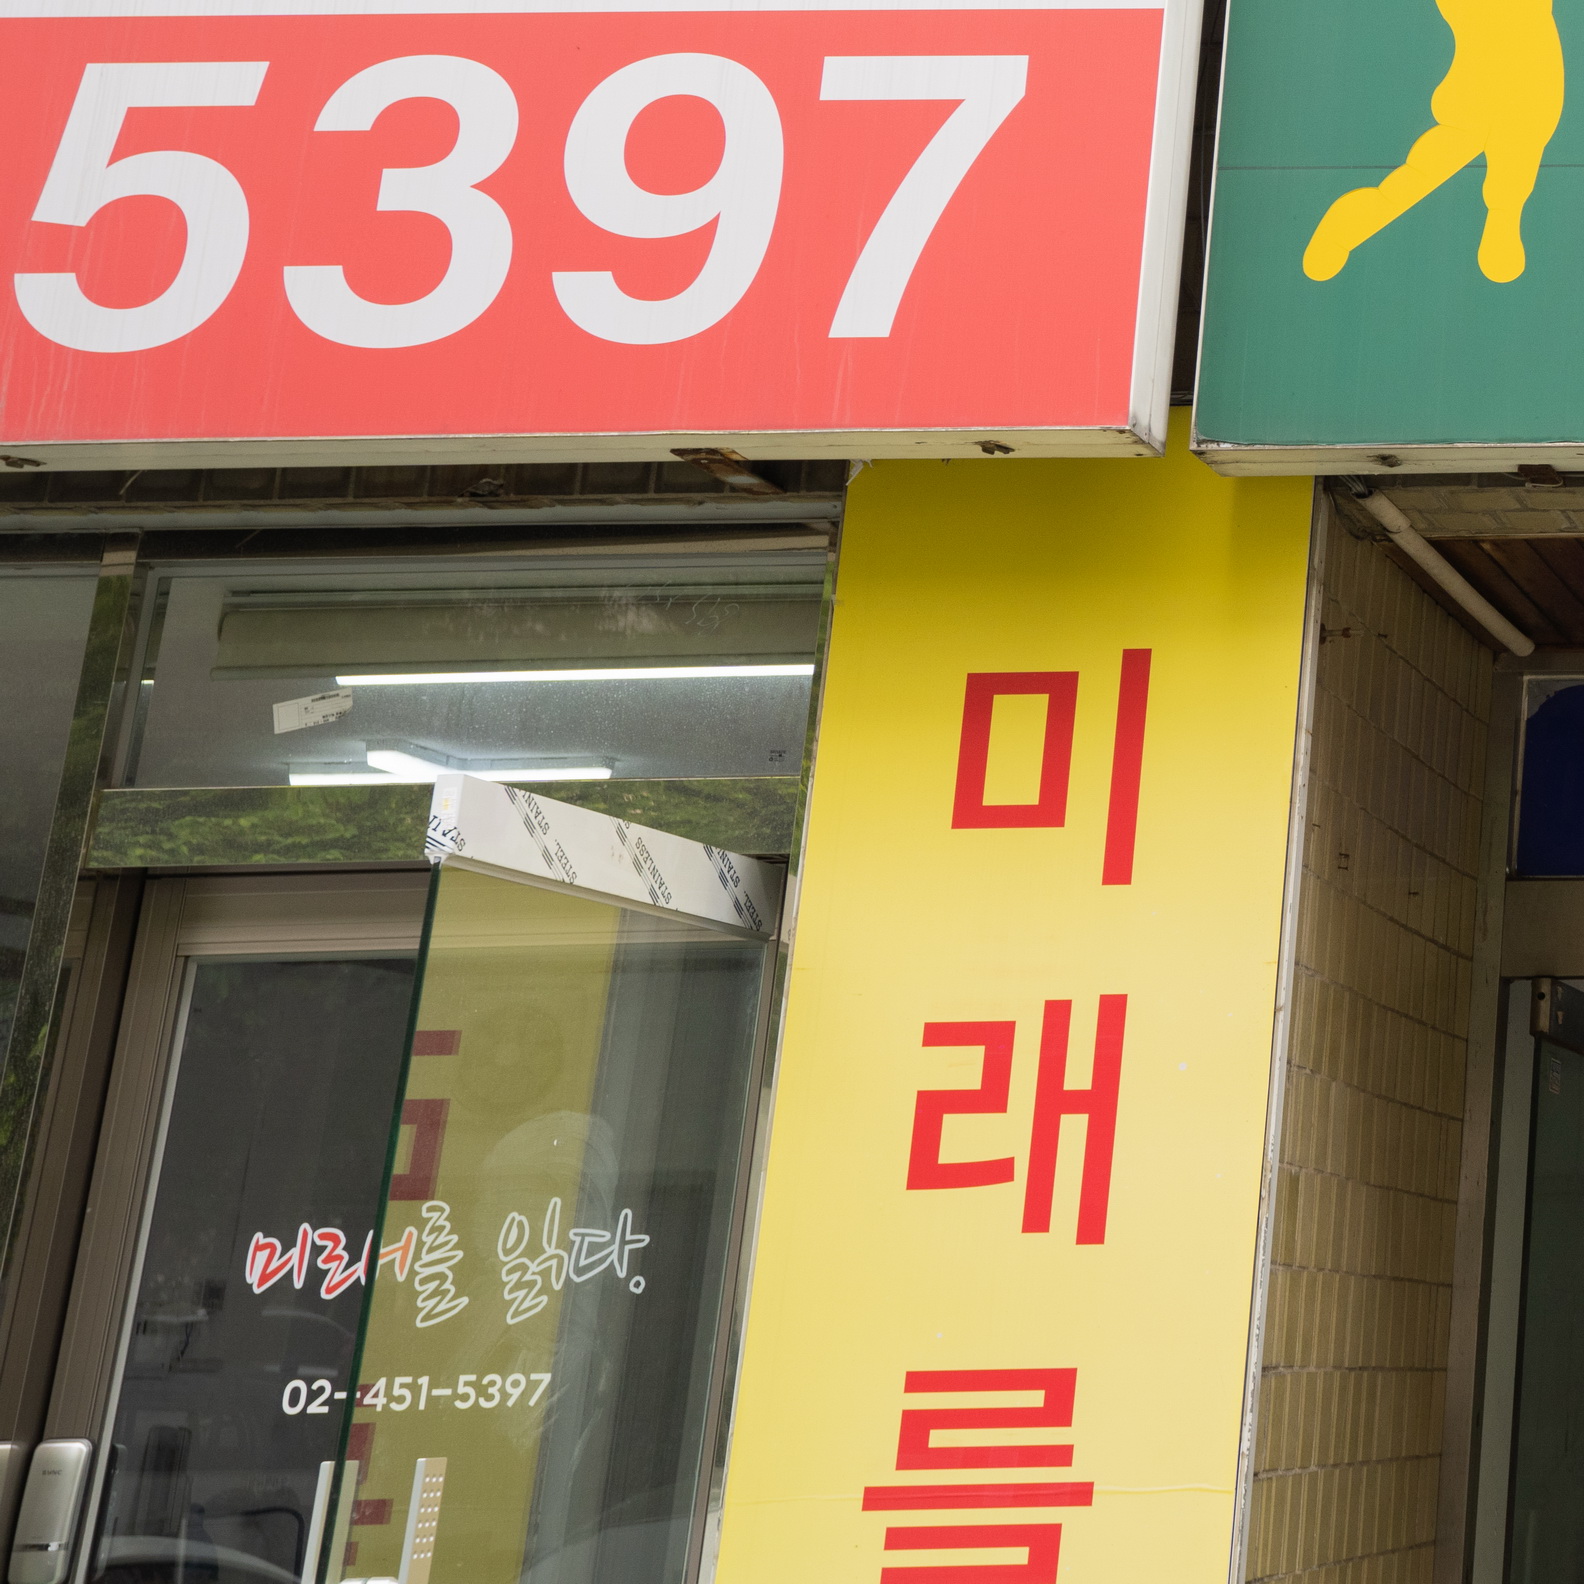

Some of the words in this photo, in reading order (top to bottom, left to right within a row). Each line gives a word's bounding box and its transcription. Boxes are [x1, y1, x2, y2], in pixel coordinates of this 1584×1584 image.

[13, 52, 1029, 354] 5397
[635, 836, 673, 905] STAINLESS
[862, 648, 1153, 1584] 미래를
